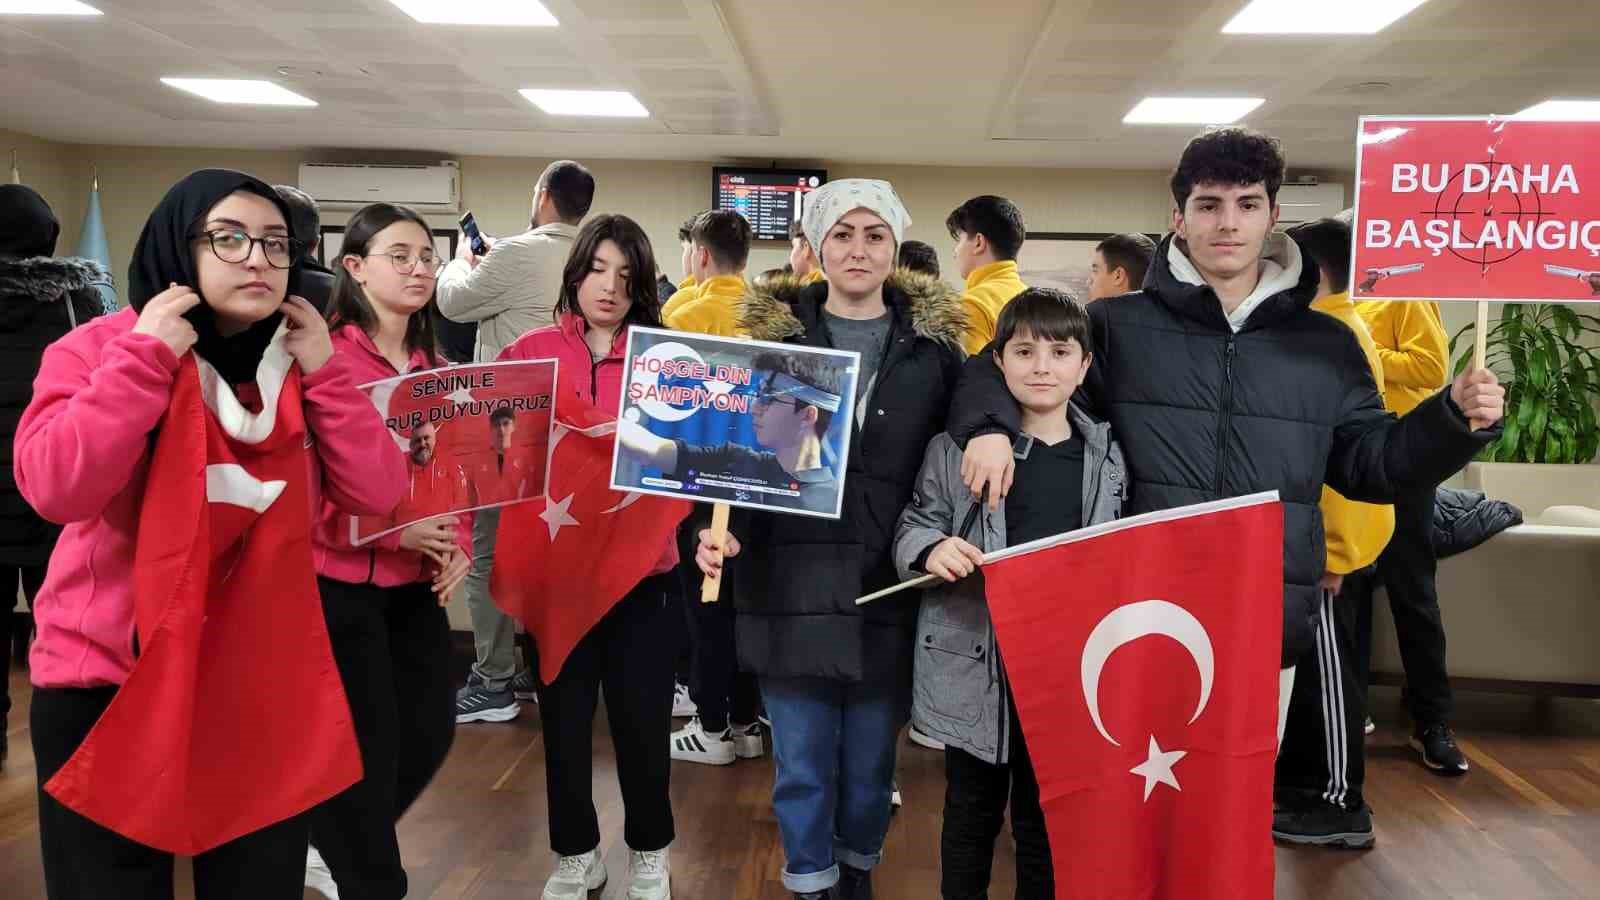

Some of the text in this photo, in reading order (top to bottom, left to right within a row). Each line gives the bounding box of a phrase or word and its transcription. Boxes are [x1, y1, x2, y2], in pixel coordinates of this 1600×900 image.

[1391, 163, 1581, 195] BU DAHA
[1364, 218, 1600, 257] BAŞLANGIÇ
[412, 372, 496, 399] SENİNLE
[632, 355, 752, 385] HOŞGELDİN
[385, 394, 551, 432] RUR DUYUYORUZ
[629, 381, 749, 414] ŞAMPİYON
